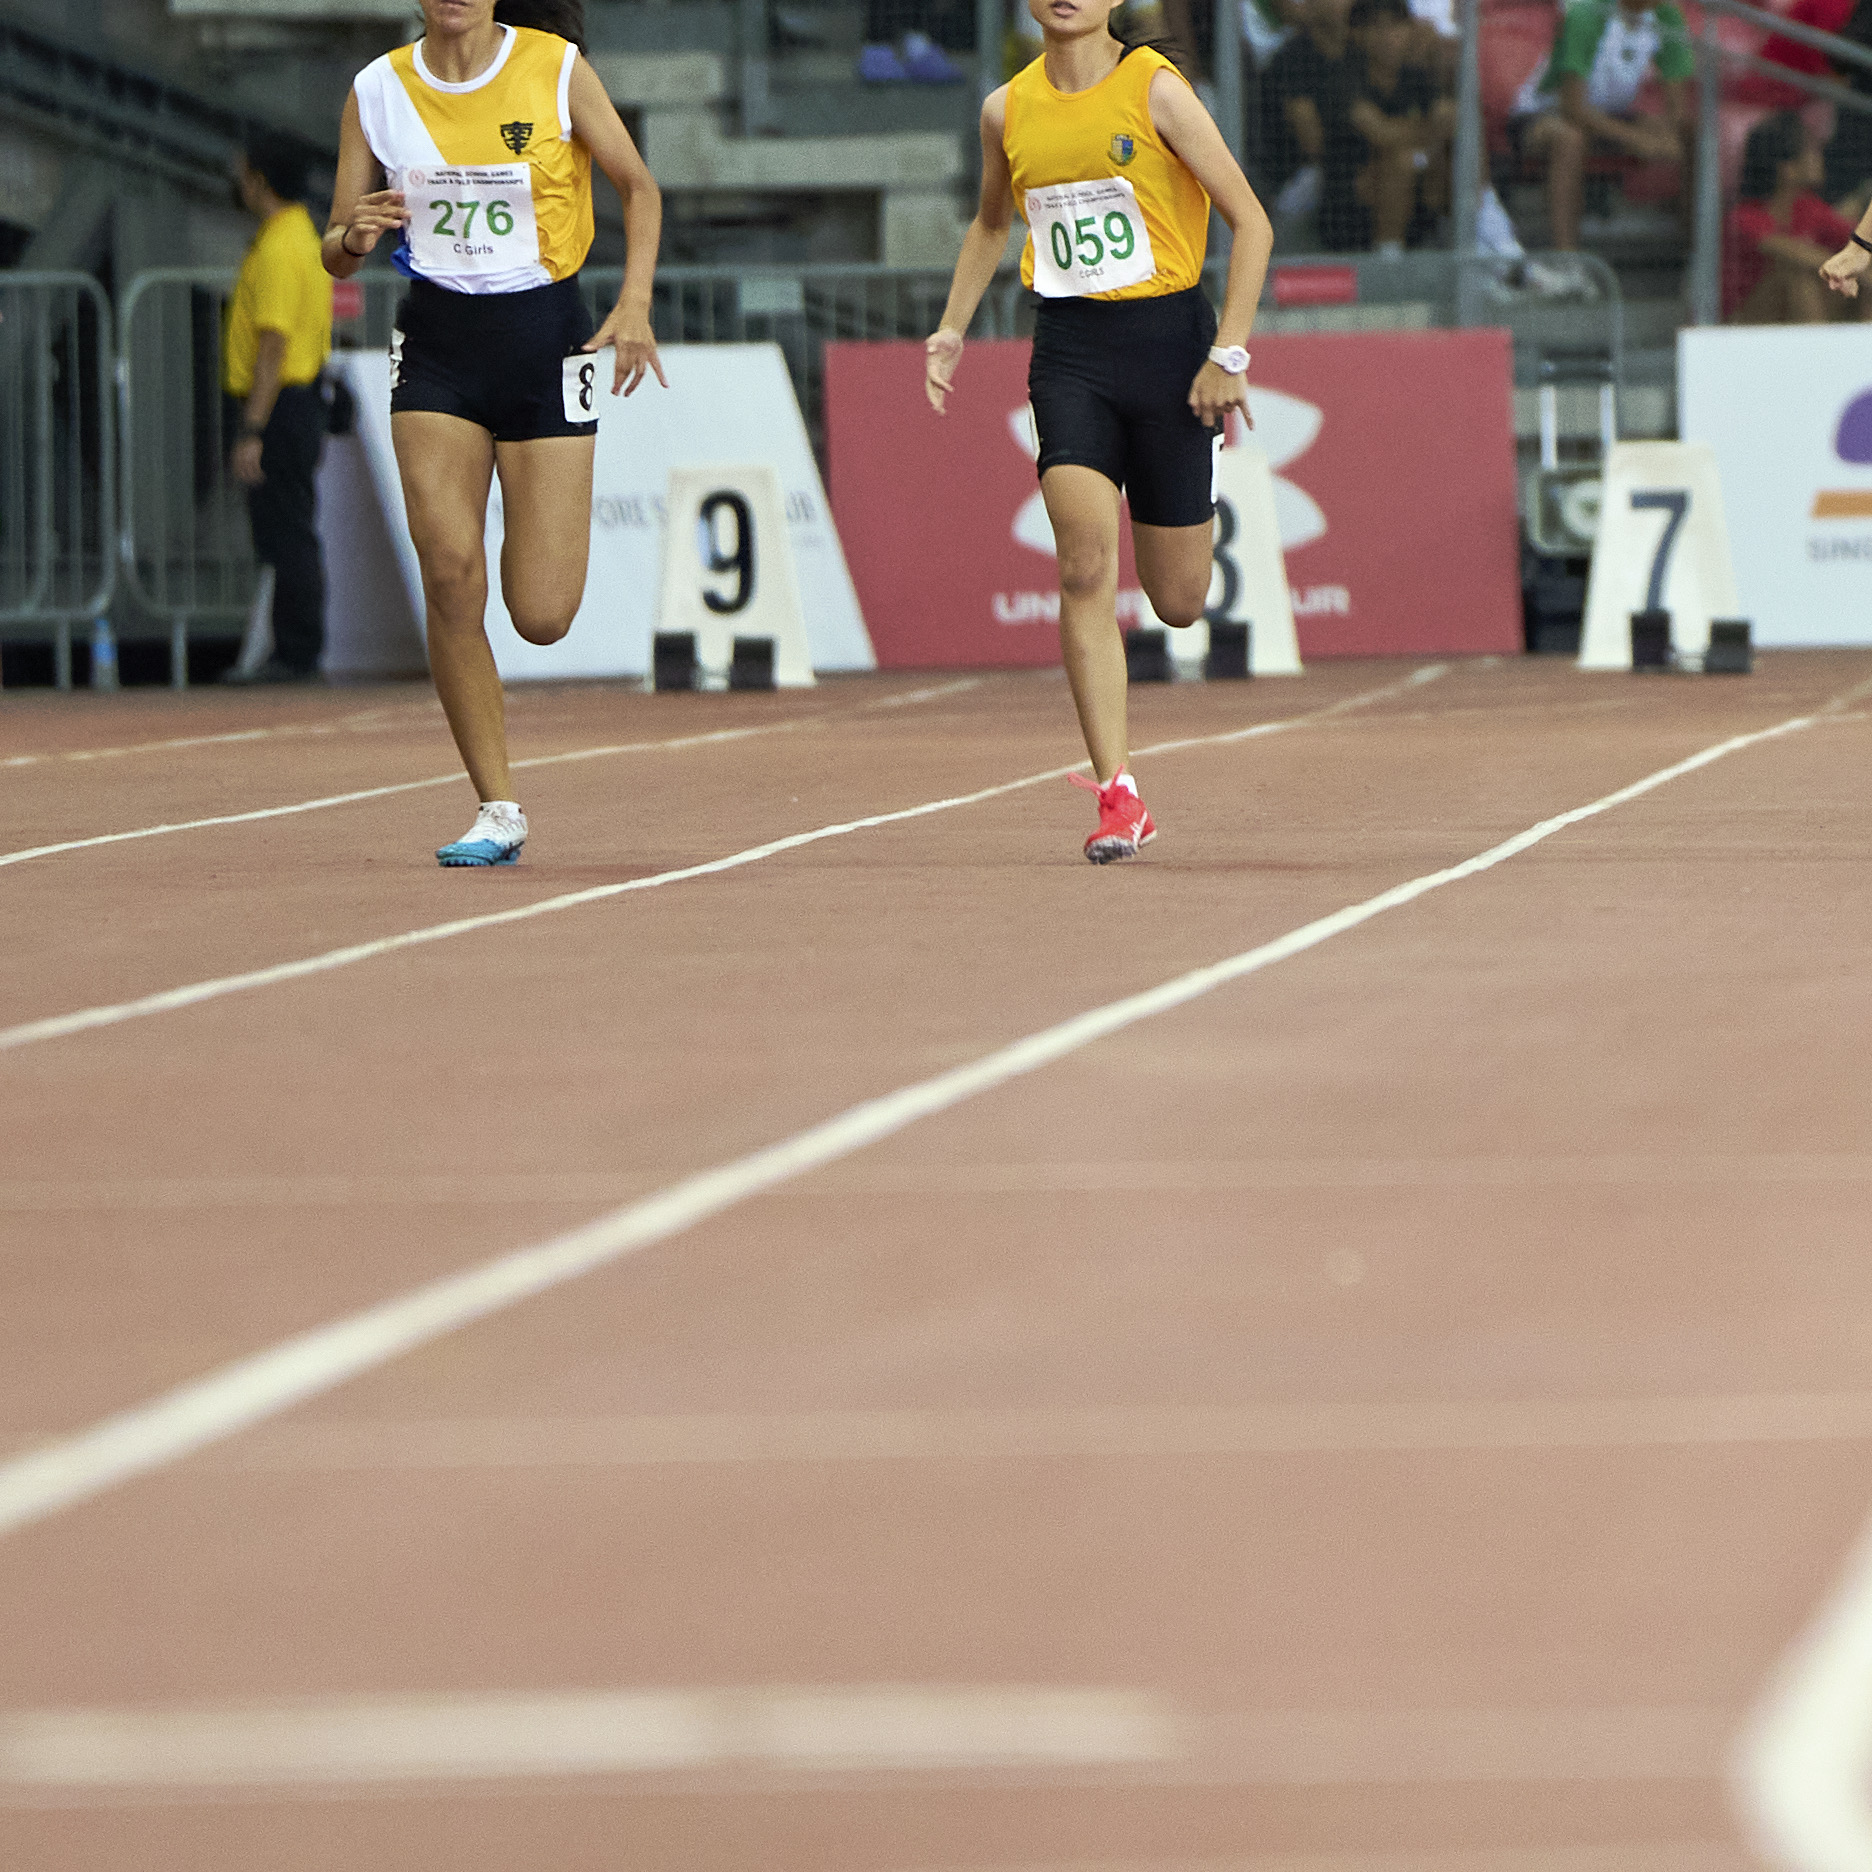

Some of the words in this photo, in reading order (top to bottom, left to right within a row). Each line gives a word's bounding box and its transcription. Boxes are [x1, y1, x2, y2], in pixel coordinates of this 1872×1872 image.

[428, 199, 514, 239] 276
[1050, 211, 1135, 270] 059
[453, 243, 462, 254] C
[465, 244, 494, 256] Girls
[698, 489, 759, 615] 9
[1629, 488, 1691, 611] 7
